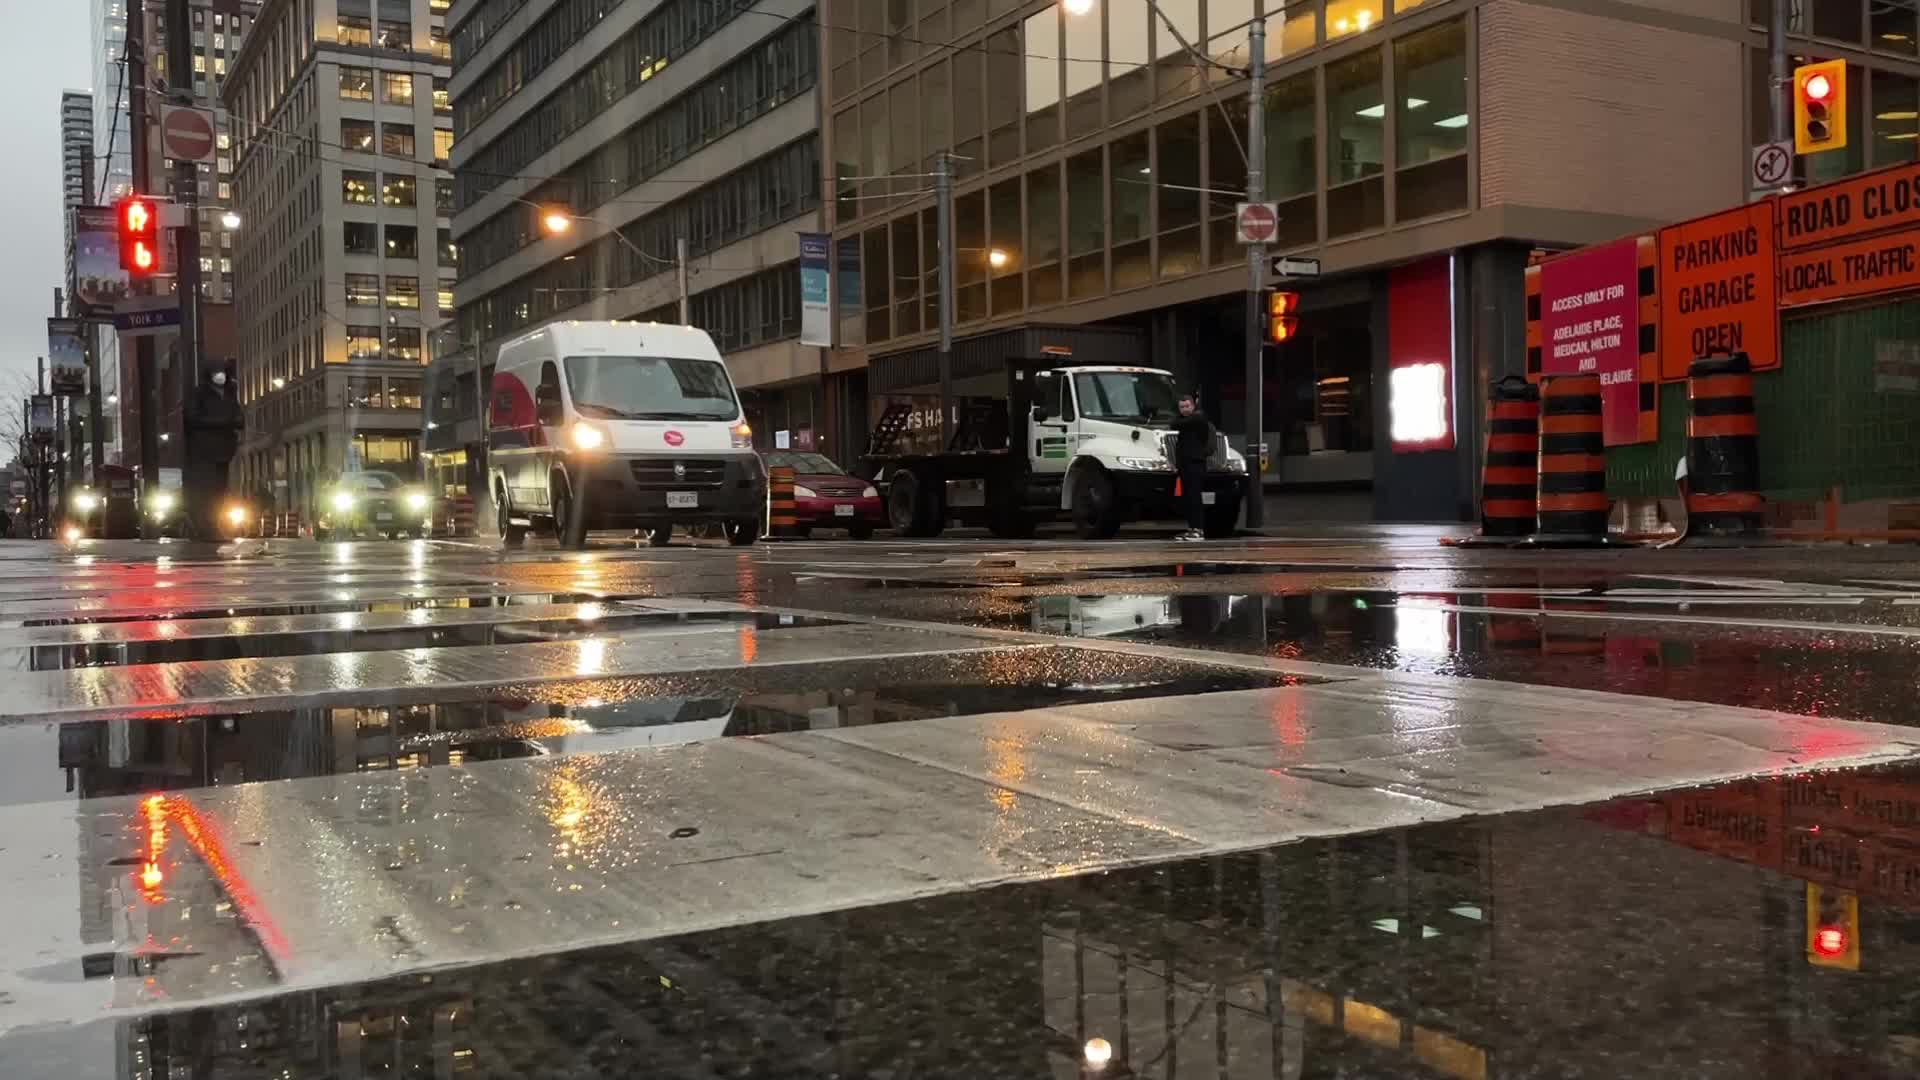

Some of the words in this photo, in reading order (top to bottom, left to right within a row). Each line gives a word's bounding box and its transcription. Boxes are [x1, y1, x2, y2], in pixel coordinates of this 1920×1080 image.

[1788, 194, 1850, 236] ROAD
[1674, 225, 1757, 273] PARKING
[1785, 259, 1837, 293] LOCAL
[1842, 244, 1915, 283] TRAFFIC
[1552, 294, 1583, 313] ACCESS
[1584, 287, 1607, 305] ONLY
[1607, 284, 1624, 300] FOR
[1679, 273, 1755, 314] GARAGE
[1553, 320, 1593, 341] ADELAIDE
[1591, 334, 1621, 353] HILTON
[1692, 320, 1744, 355] OPEN
[1579, 357, 1597, 372] AND
